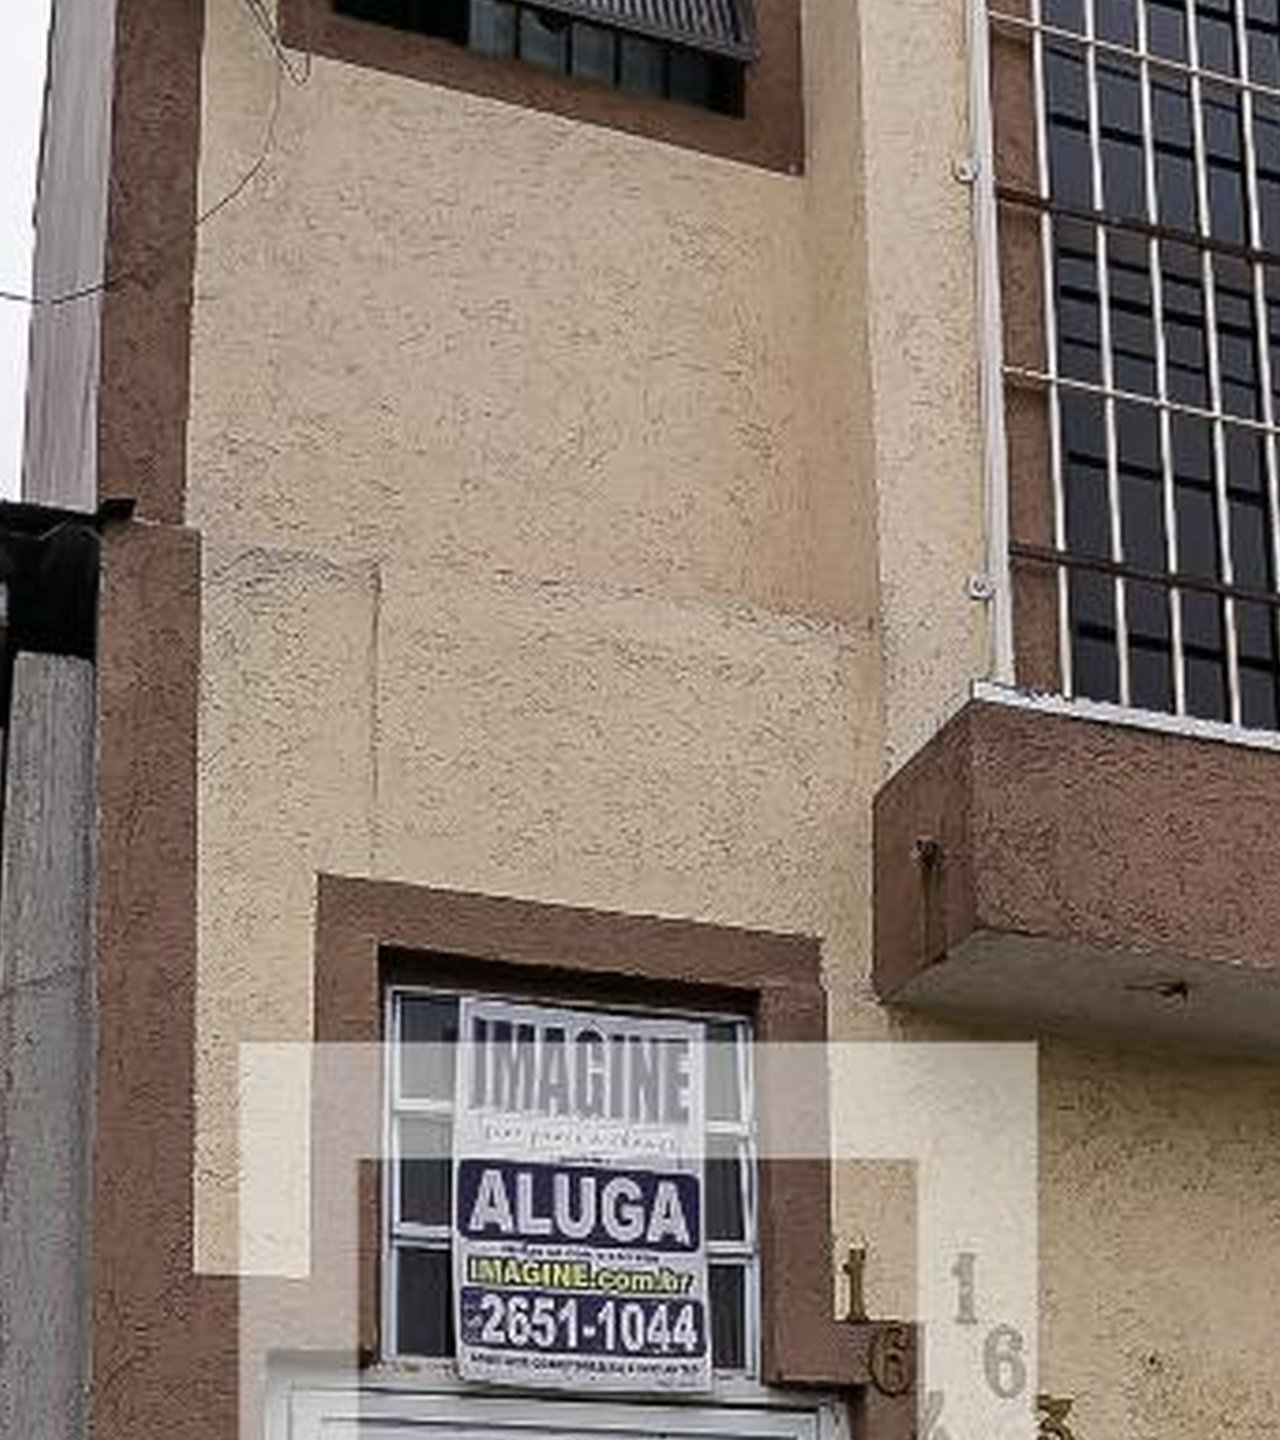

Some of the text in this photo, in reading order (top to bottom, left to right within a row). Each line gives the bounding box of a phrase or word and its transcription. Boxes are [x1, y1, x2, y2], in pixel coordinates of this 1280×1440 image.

[467, 1017, 691, 1124] IMAGINE
[469, 1168, 691, 1246] ALUGA
[480, 1292, 699, 1353] 2651-1044
